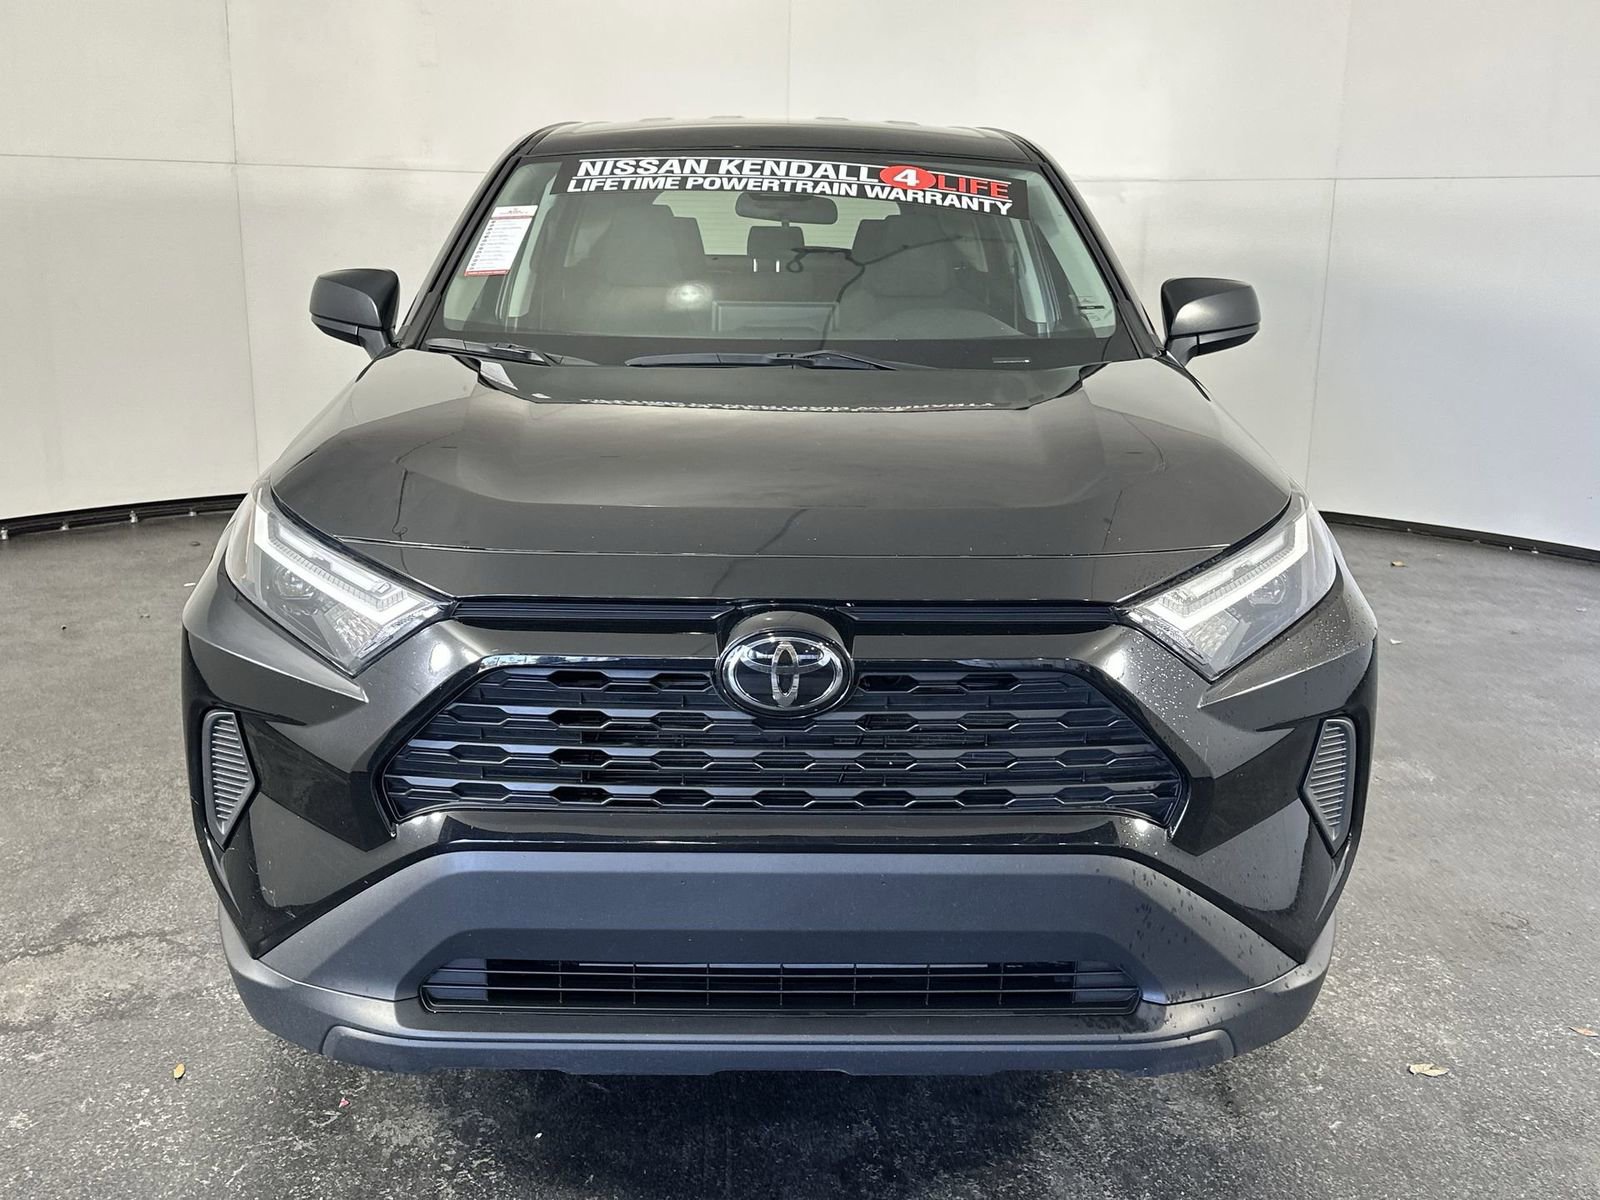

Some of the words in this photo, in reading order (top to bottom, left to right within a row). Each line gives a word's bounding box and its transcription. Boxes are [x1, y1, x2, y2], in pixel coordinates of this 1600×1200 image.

[567, 177, 681, 192] LIFETIME
[685, 177, 857, 197] POWERTRAIN
[864, 184, 1013, 216] WARRANTY
[577, 159, 708, 177] NISSAN
[718, 159, 879, 182] KENDALL
[893, 169, 920, 187] 4
[938, 175, 1009, 199] LIFE
